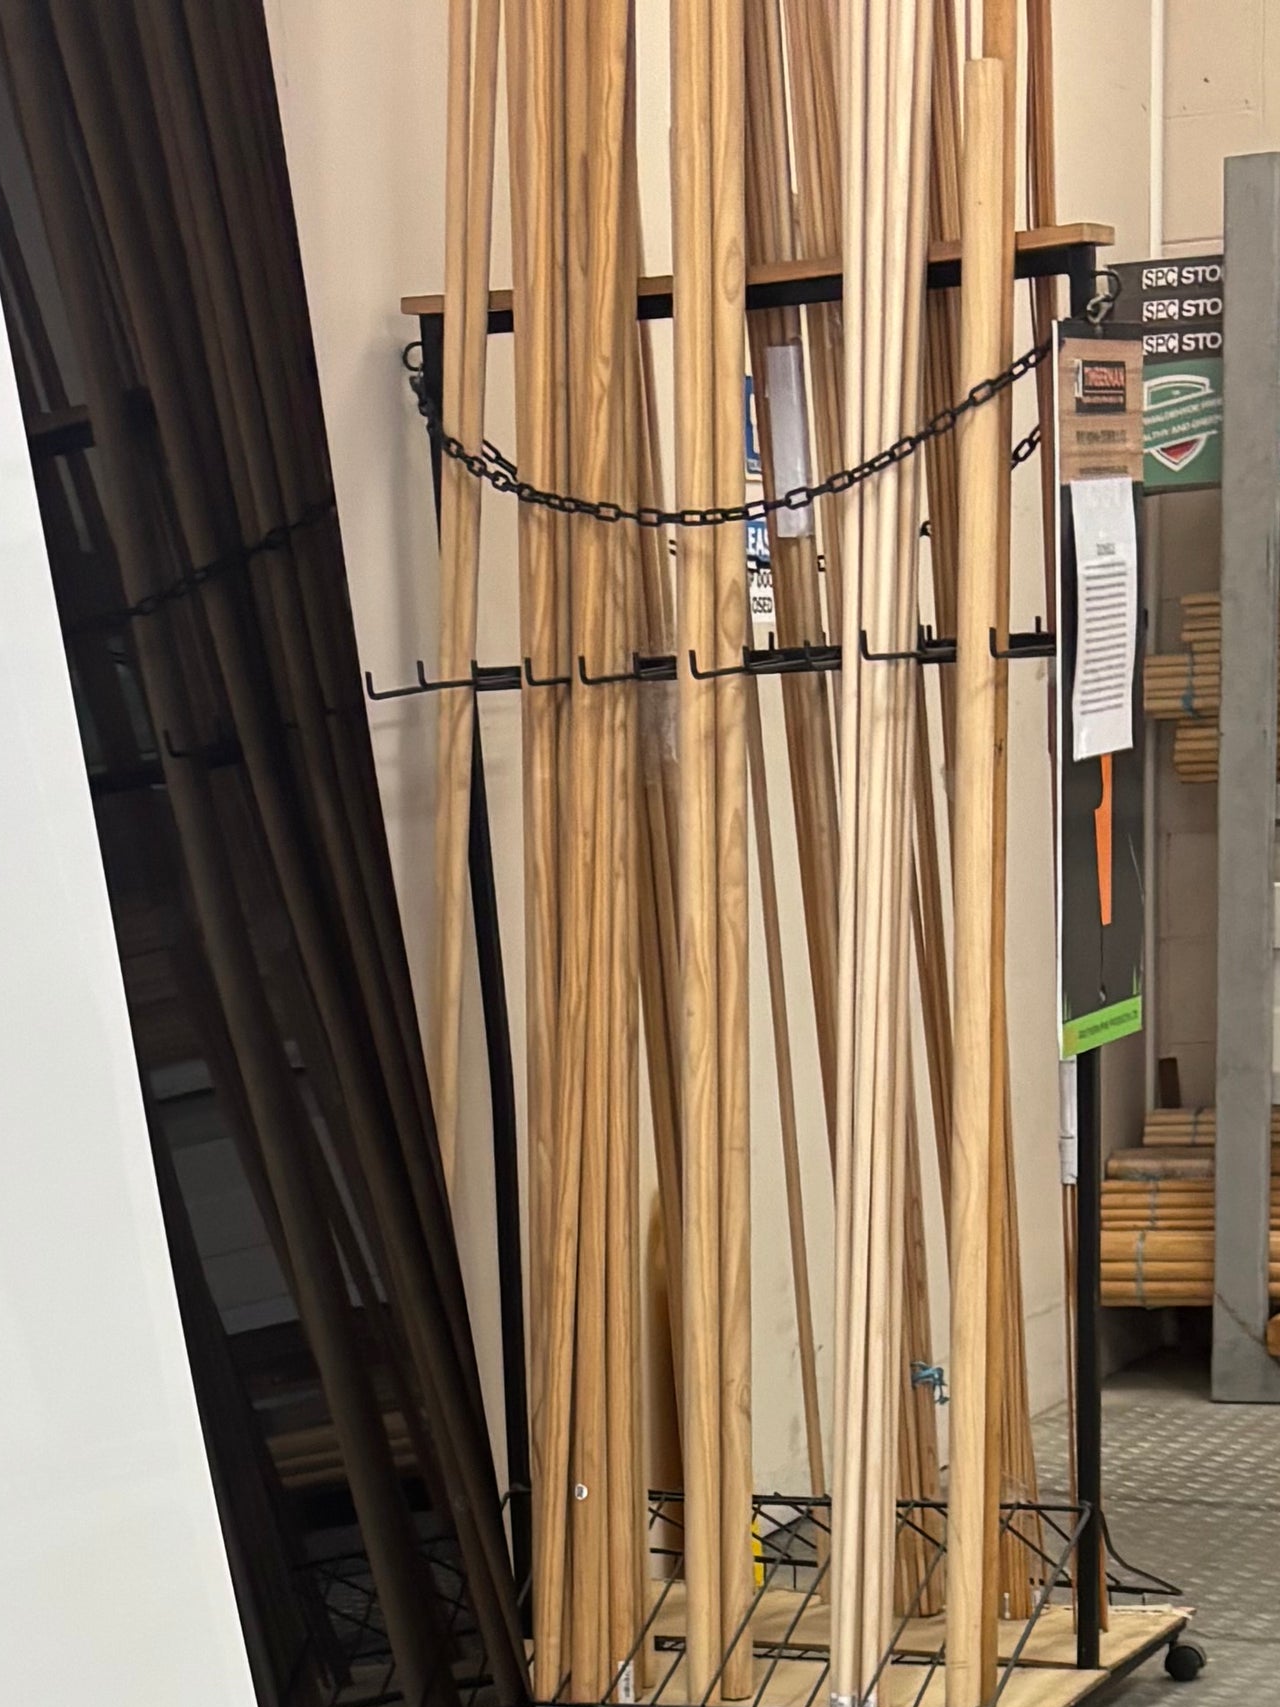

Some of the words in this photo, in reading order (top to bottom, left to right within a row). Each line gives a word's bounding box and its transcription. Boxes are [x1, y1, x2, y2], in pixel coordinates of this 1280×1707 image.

[1142, 266, 1178, 289] SPC
[1181, 265, 1222, 284] STO
[1142, 299, 1178, 322] SPC
[1181, 298, 1222, 317] STO
[1142, 333, 1178, 355] SPC
[1181, 332, 1222, 351] STO
